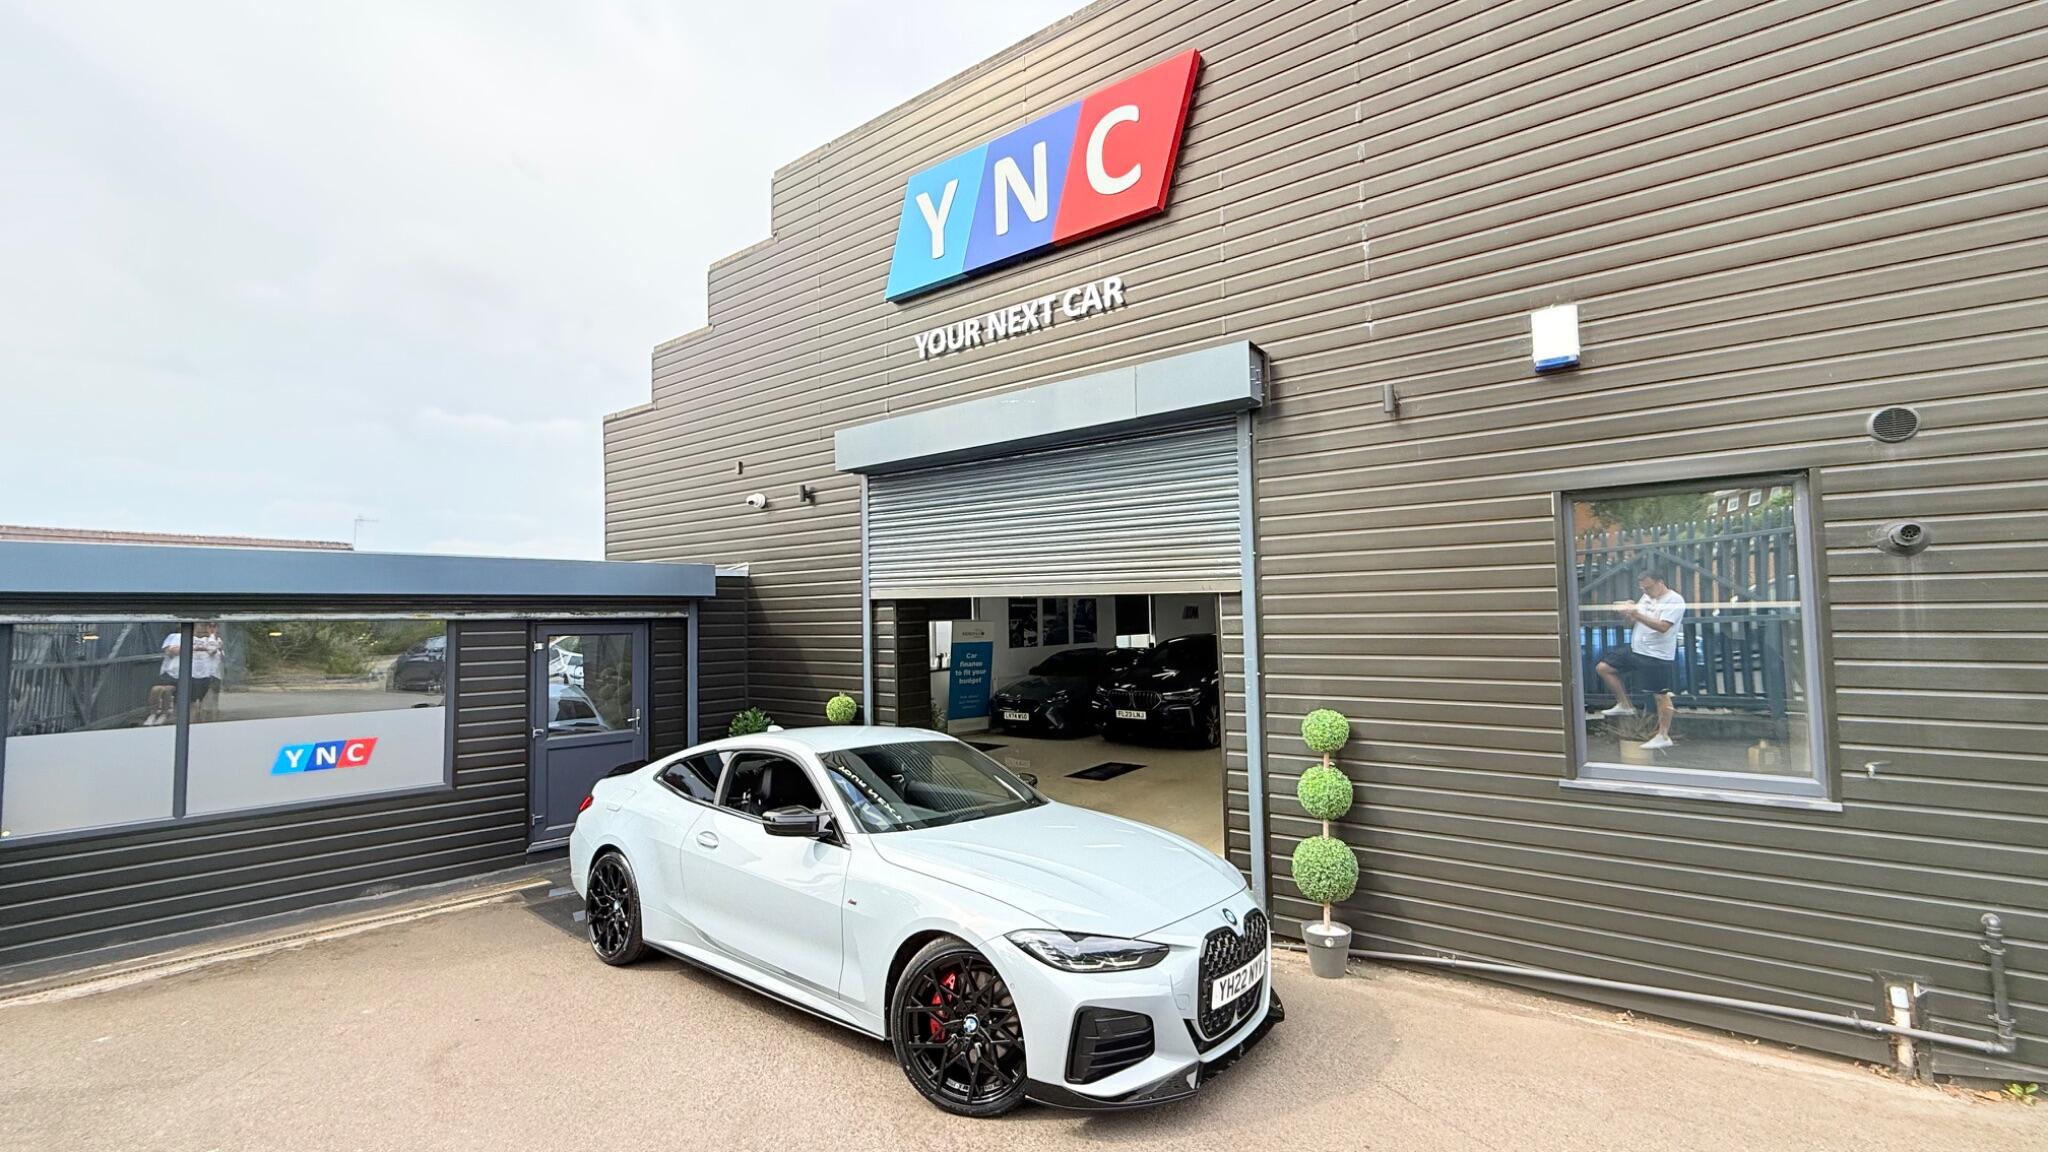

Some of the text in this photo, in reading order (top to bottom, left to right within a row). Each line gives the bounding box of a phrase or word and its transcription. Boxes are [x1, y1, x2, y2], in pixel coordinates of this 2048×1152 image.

[916, 104, 1142, 259] YNC
[914, 276, 1125, 359] YOUR NEXT CAR
[959, 660, 983, 668] finance
[285, 743, 365, 768] YNC
[1219, 968, 1248, 1001] YH22
